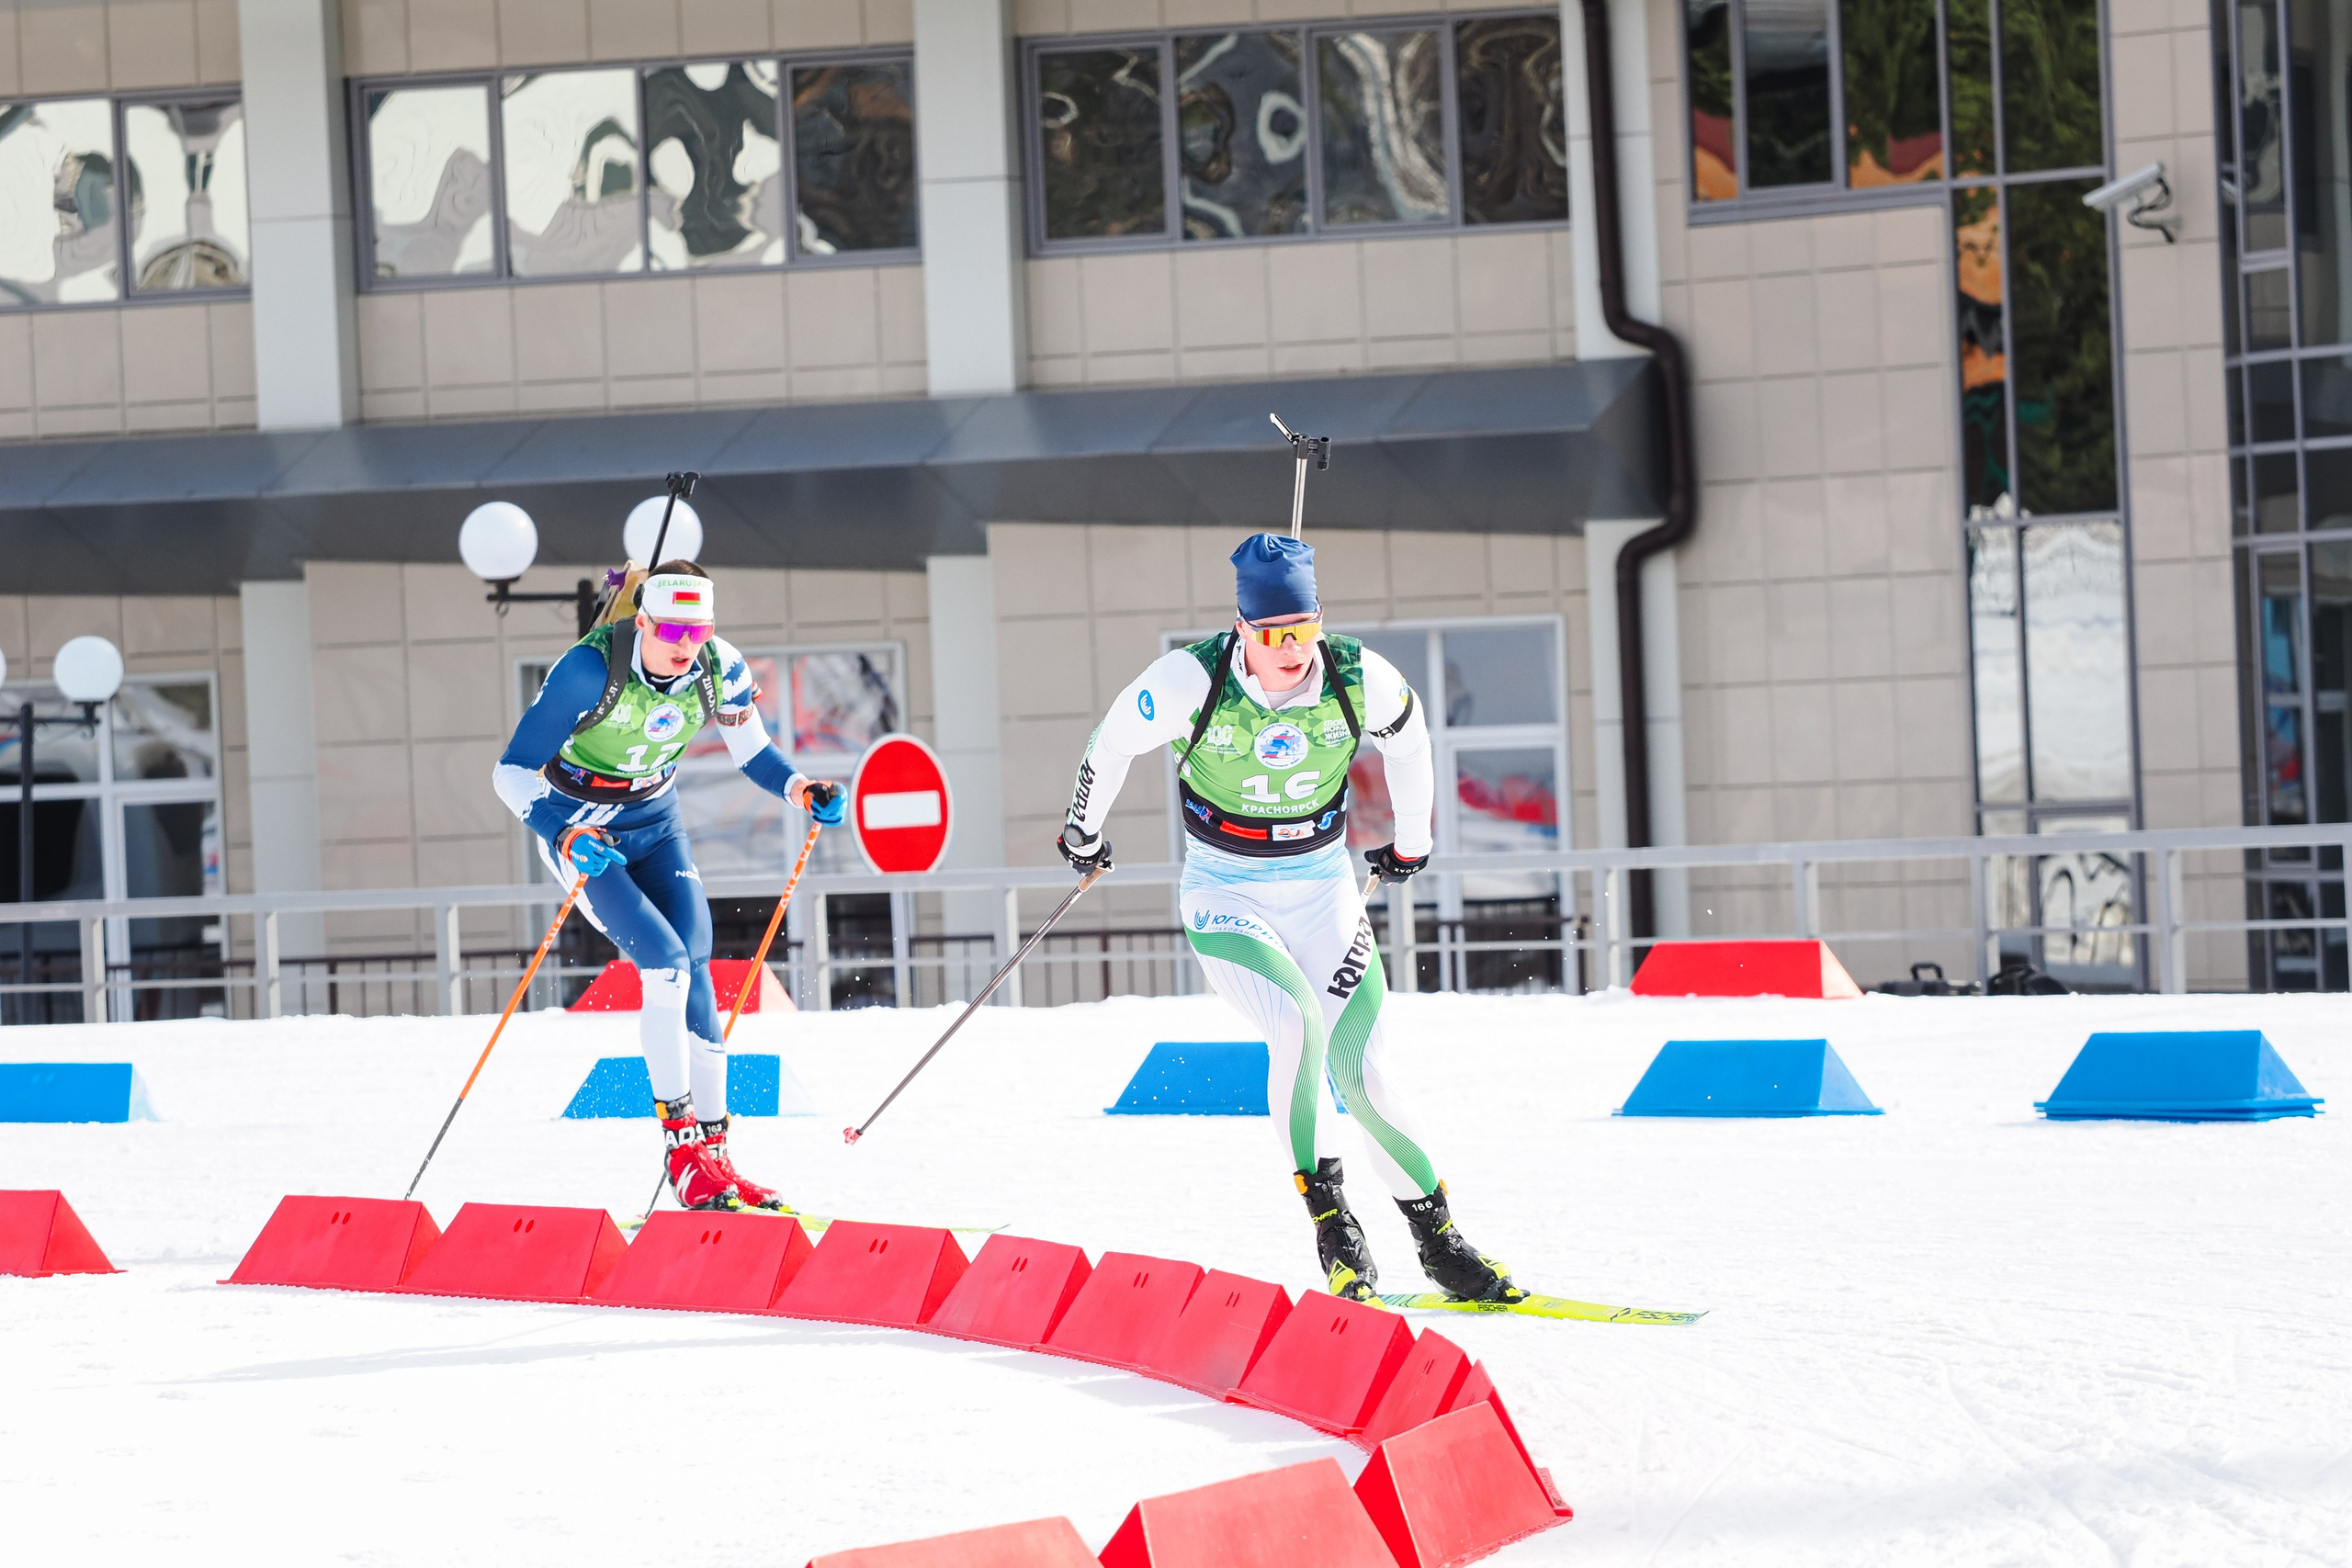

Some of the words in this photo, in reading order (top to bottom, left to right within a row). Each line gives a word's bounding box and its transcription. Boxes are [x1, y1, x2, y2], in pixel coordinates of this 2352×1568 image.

[1240, 770, 1321, 804] 16
[1241, 798, 1320, 815] КРАСНОЯРСК
[1411, 1200, 1433, 1212] 166
[1477, 1303, 1509, 1313] FISCHER
[1630, 1310, 1699, 1322] FISCHER
